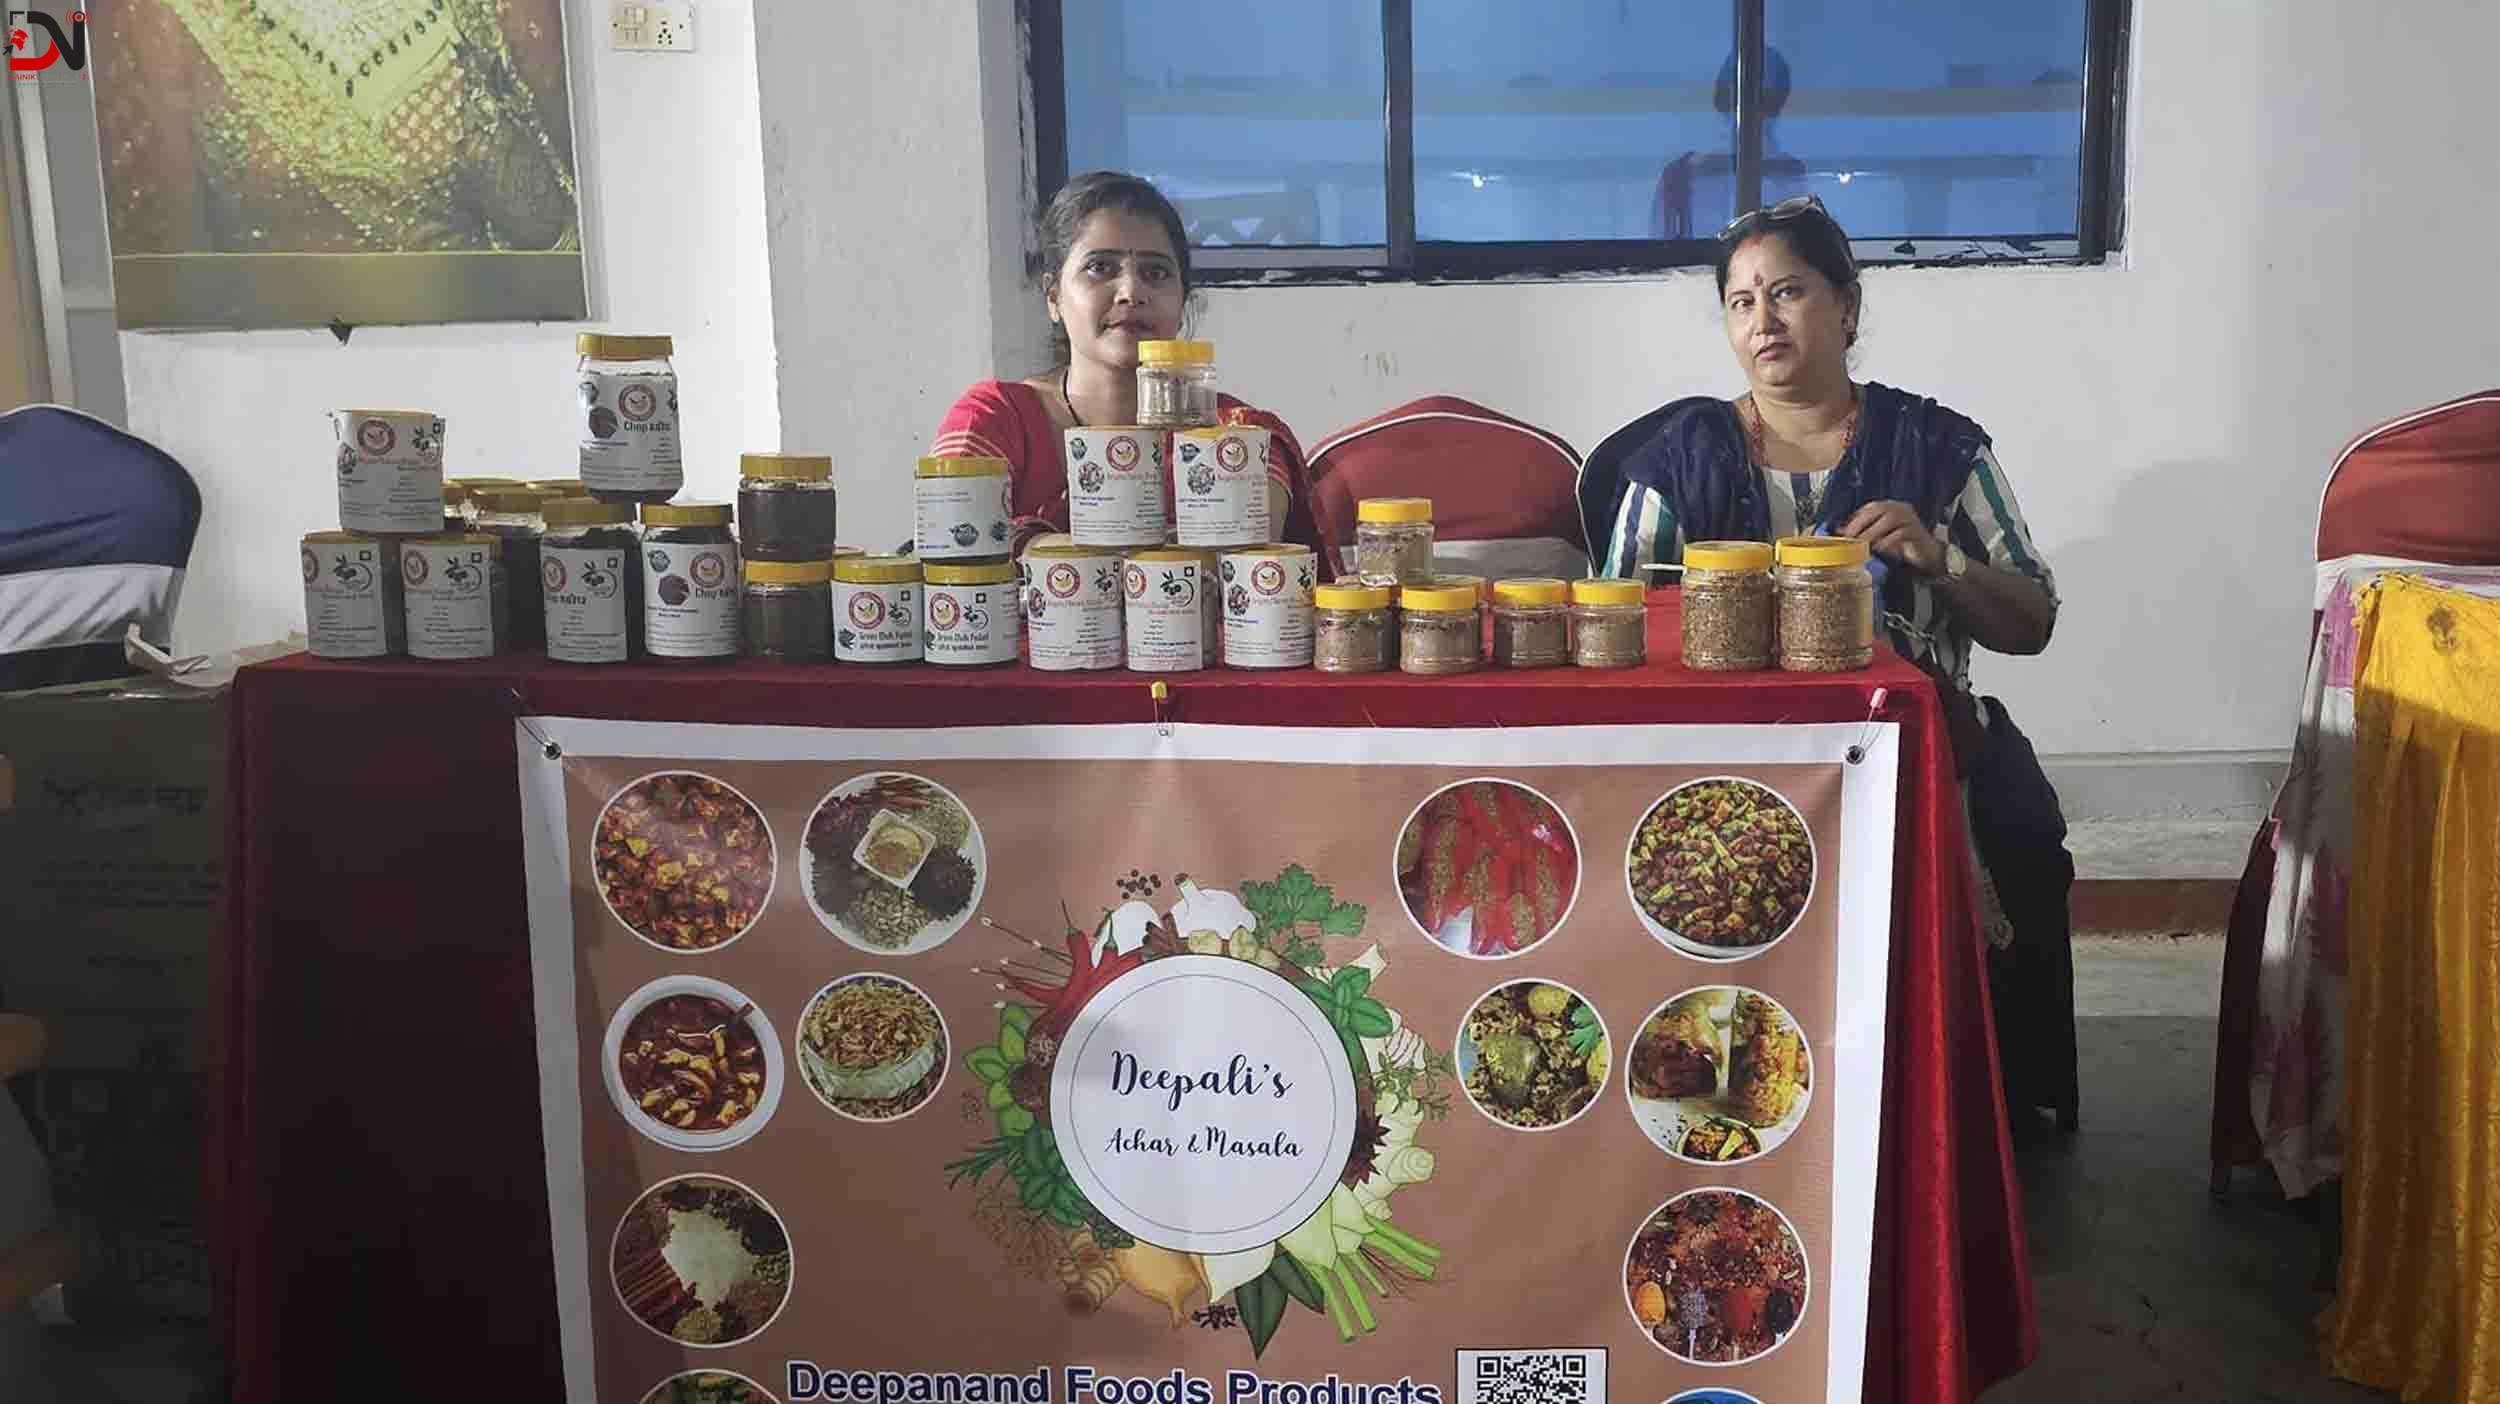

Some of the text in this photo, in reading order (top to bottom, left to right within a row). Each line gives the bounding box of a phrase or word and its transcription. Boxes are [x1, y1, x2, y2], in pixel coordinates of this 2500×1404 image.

[1111, 1050, 1293, 1111] Deepali's
[1104, 1127, 1178, 1157] Achar
[1204, 1125, 1304, 1158] Masala
[788, 1361, 1441, 1404] Deepanand Foods Products
